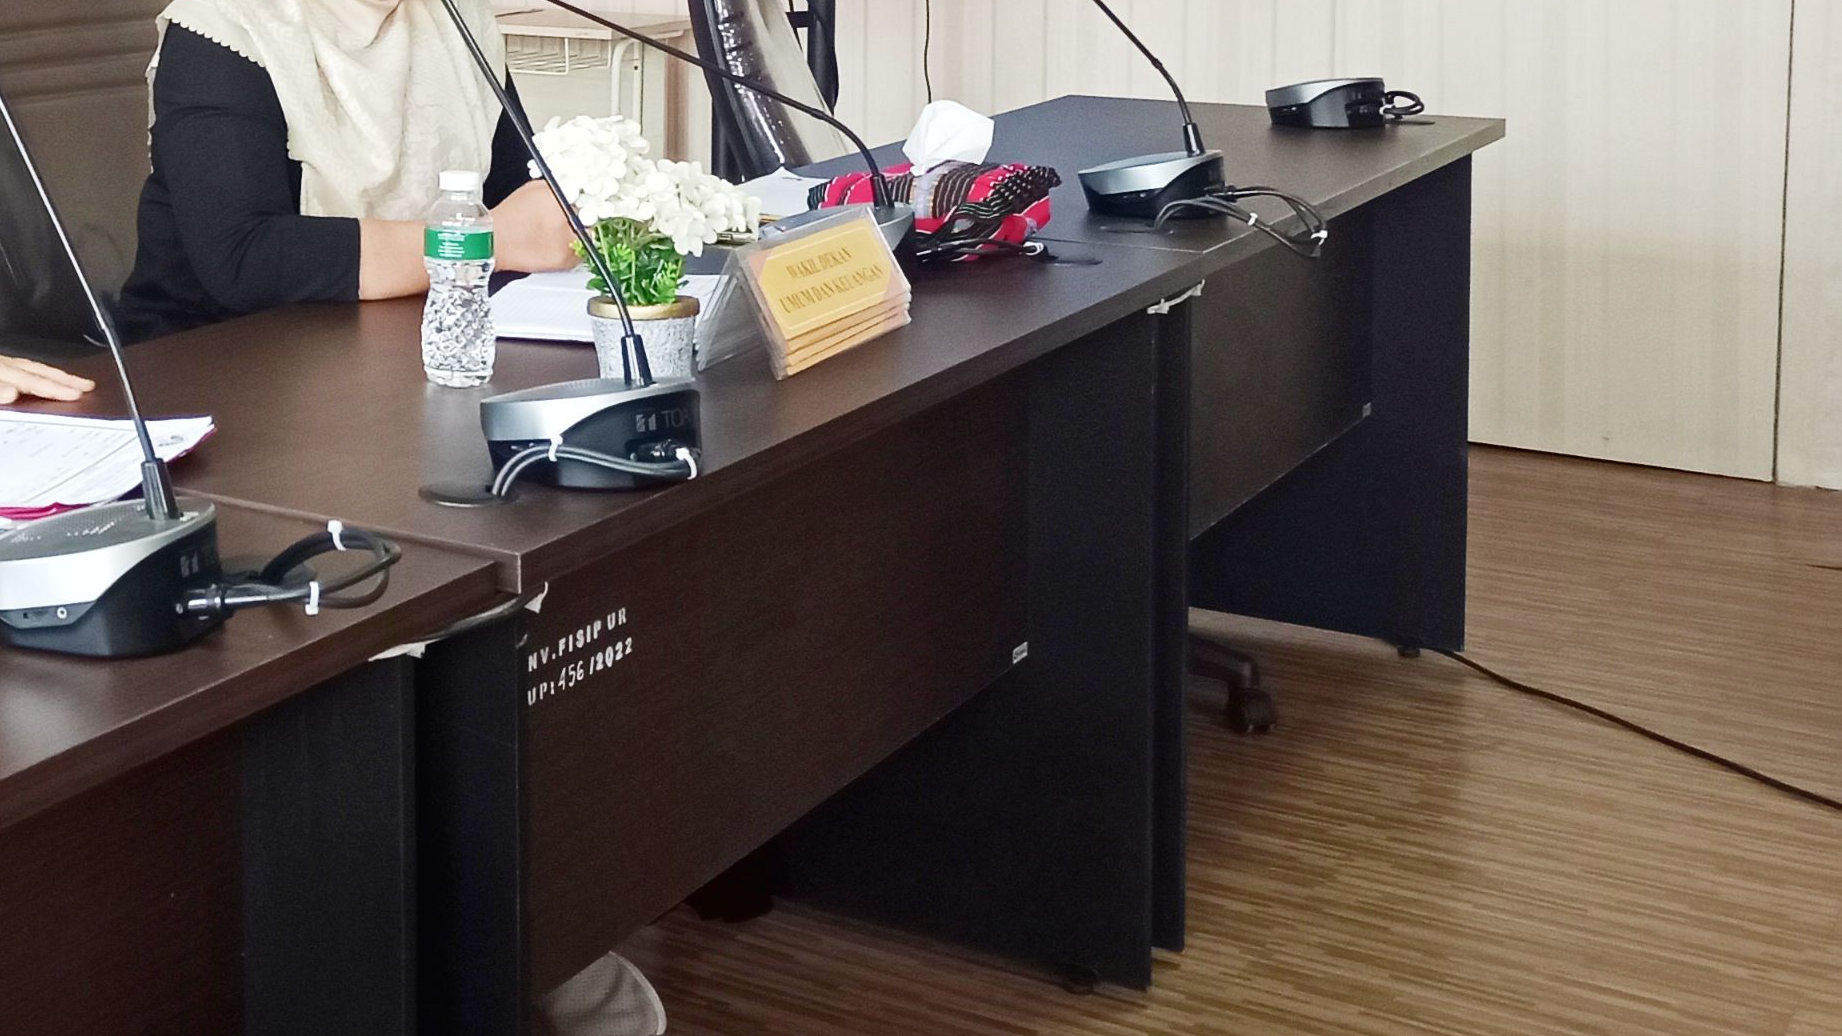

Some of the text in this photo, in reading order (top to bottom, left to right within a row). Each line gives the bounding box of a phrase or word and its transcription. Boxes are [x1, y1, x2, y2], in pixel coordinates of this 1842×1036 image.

[786, 247, 851, 279] WAKIL DEKAN
[779, 264, 883, 313] UMUM DAN KEUANGAN
